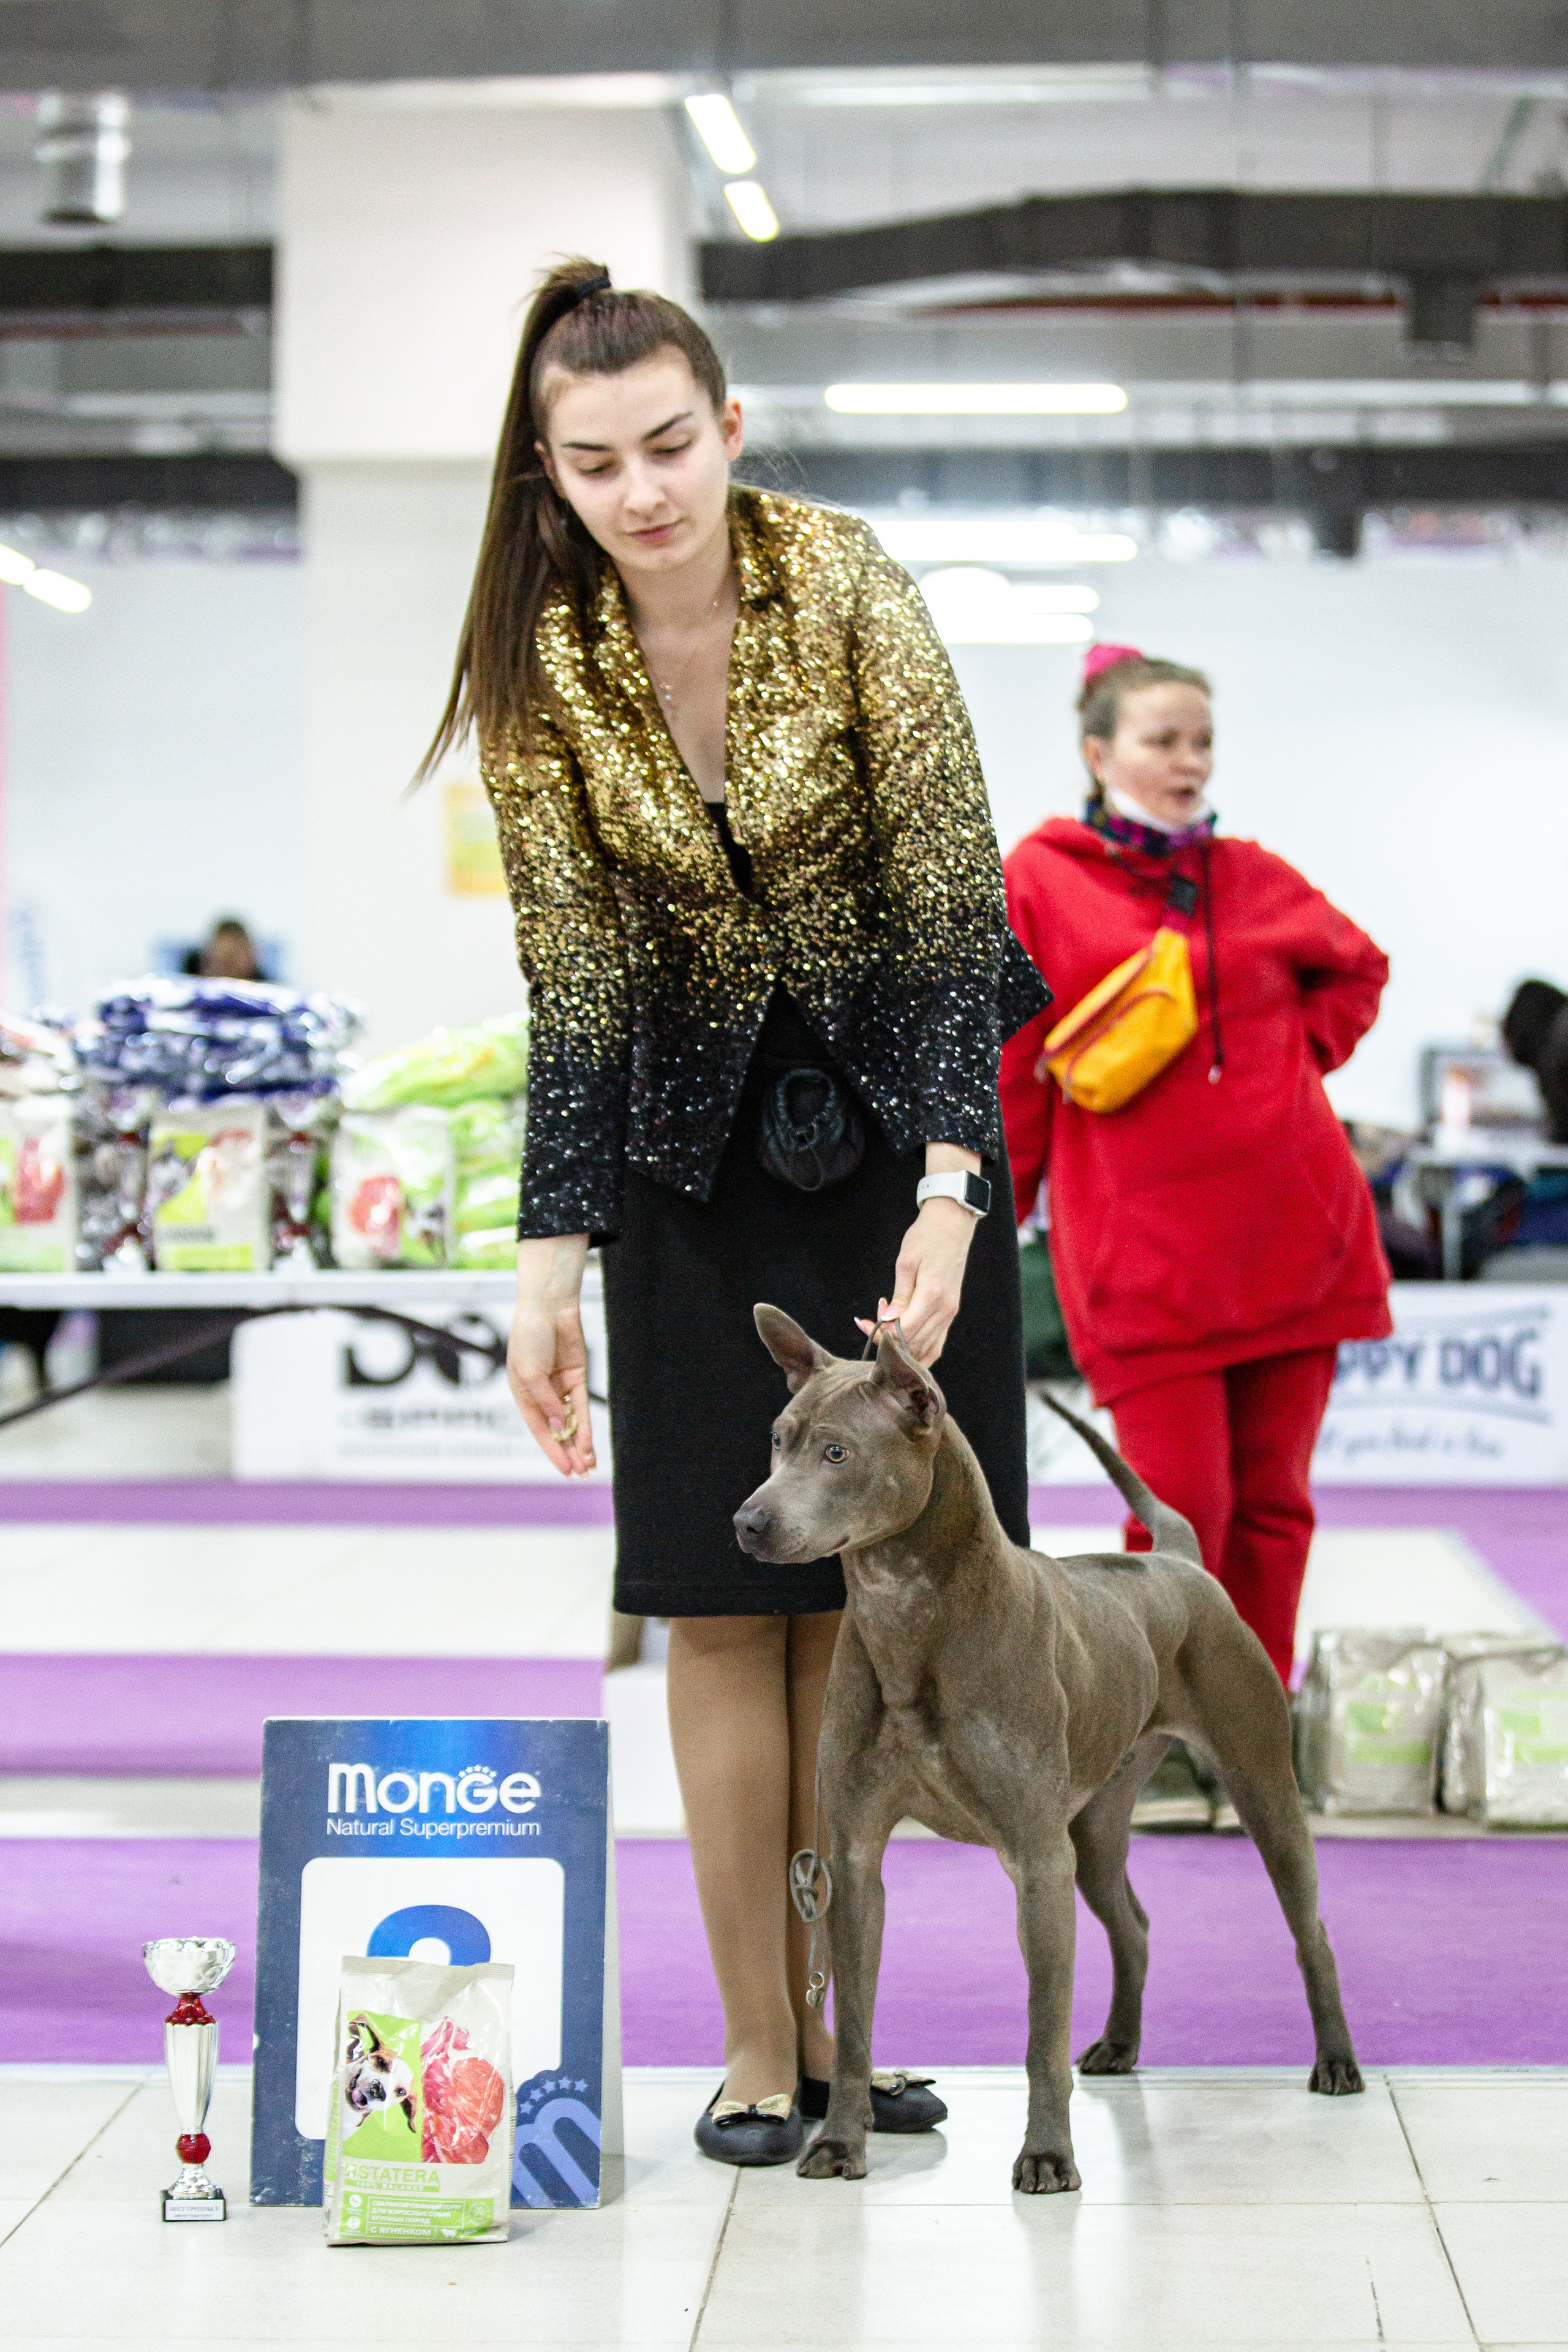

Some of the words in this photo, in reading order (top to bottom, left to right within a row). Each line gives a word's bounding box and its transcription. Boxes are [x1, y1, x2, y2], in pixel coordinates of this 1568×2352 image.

[1440, 1329, 1541, 1398] DOG
[326, 1819, 394, 1836] Natural
[400, 1818, 540, 1839] Superpremium
[382, 2183, 424, 2192] BALANCE
